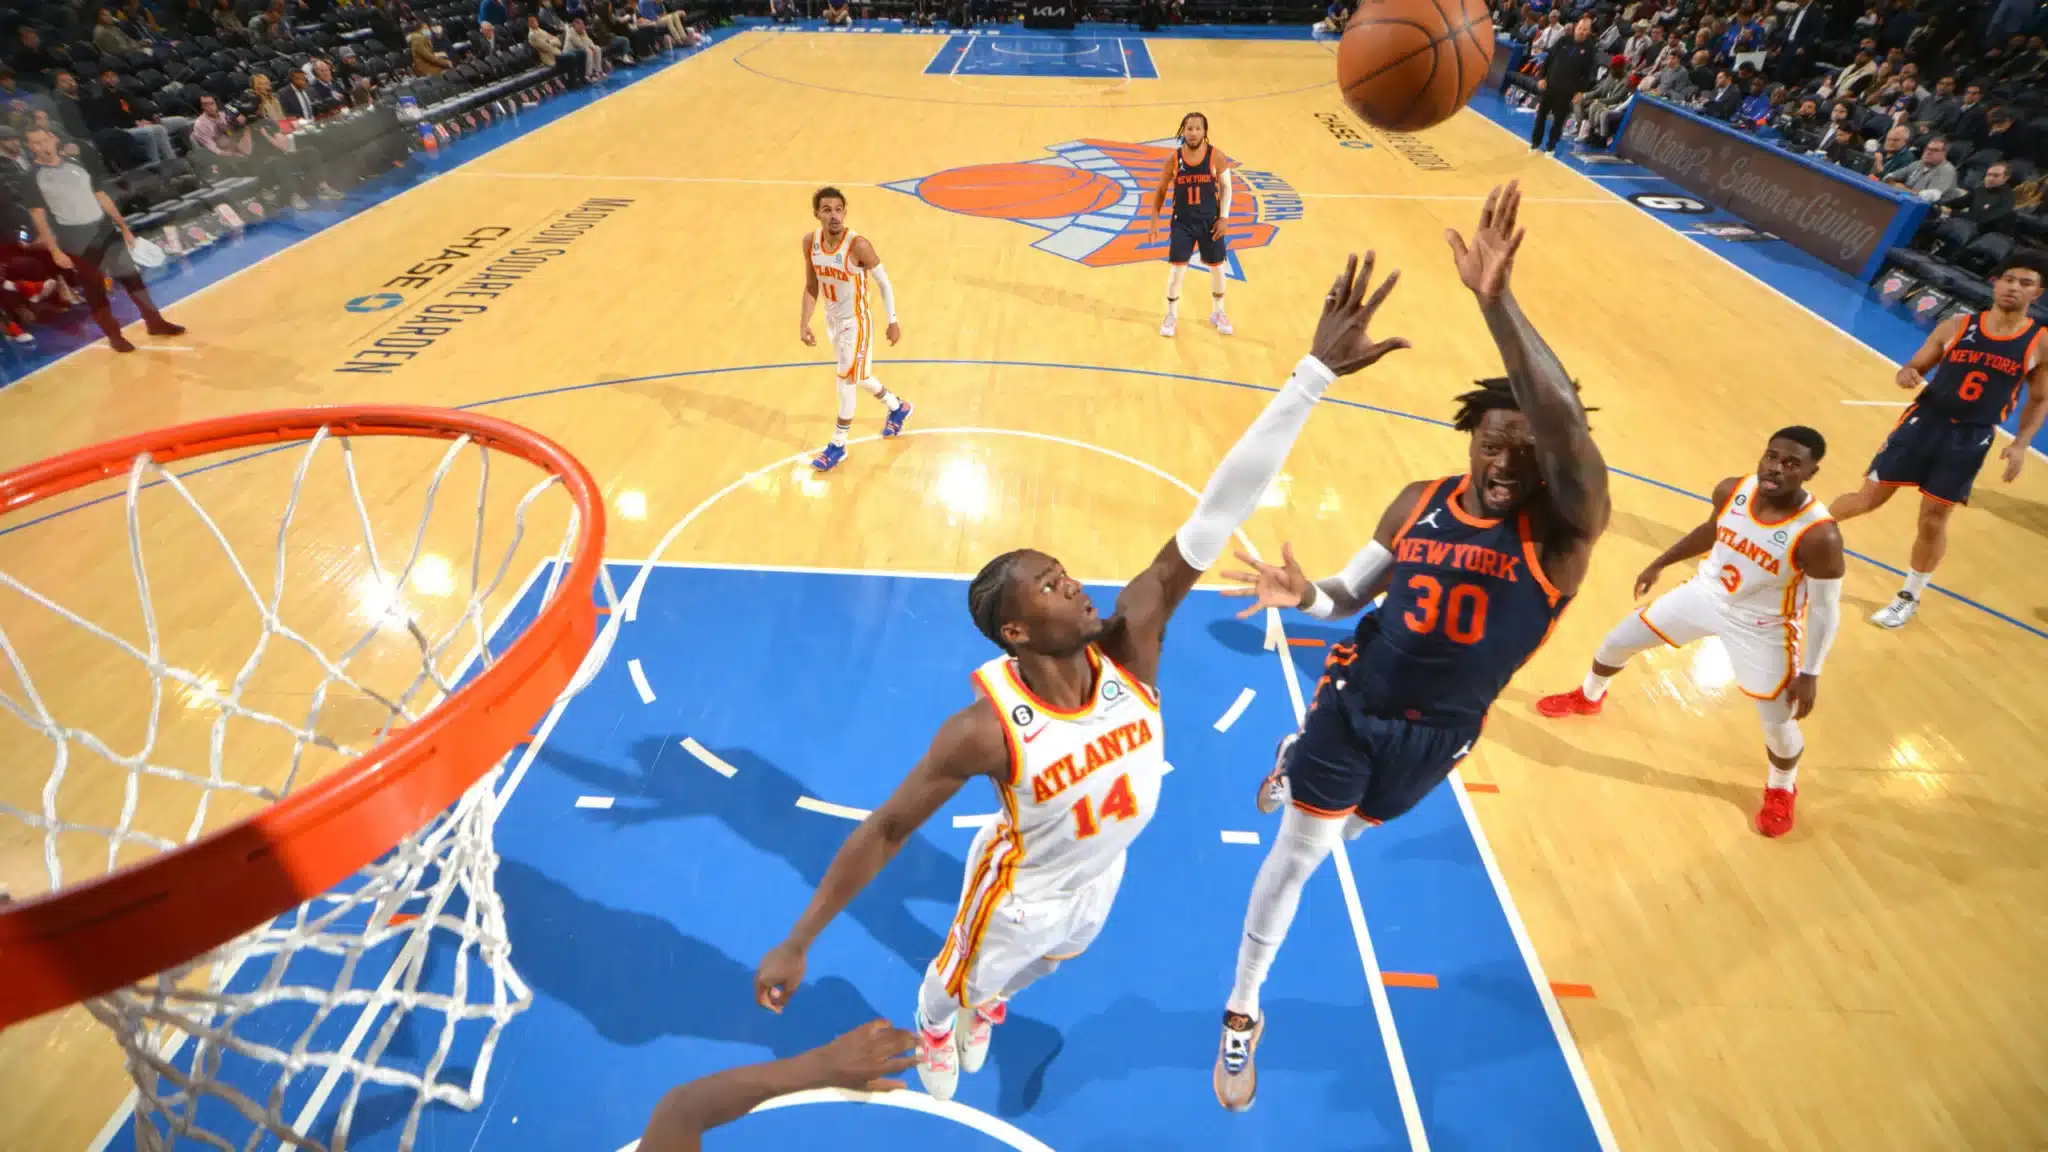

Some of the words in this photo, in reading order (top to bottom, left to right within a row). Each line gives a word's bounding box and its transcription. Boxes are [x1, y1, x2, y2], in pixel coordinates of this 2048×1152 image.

[1032, 6, 1066, 17] KIA
[1314, 112, 1361, 139] CHASE
[1193, 174, 1211, 184] YORK
[1237, 169, 1294, 192] NEW
[1187, 186, 1200, 205] 11
[1261, 194, 1304, 222] YORK
[1718, 157, 1792, 214] Season
[1797, 192, 1877, 261] Giving
[525, 197, 636, 245] MADISON
[383, 226, 512, 290] CHASE
[444, 247, 566, 300] SQUARE
[822, 282, 838, 302] 11
[333, 303, 488, 374] GARDEN
[1948, 349, 1982, 364] NEW
[1983, 352, 2021, 377] YORK
[1957, 370, 1989, 402] 6
[1396, 537, 1454, 570] NEW
[1450, 543, 1521, 583] YORK
[1720, 563, 1742, 594] 3
[1403, 573, 1489, 646] 30
[1015, 706, 1031, 725] 6
[1031, 718, 1153, 805] ATLANTA
[1070, 772, 1139, 841] 14
